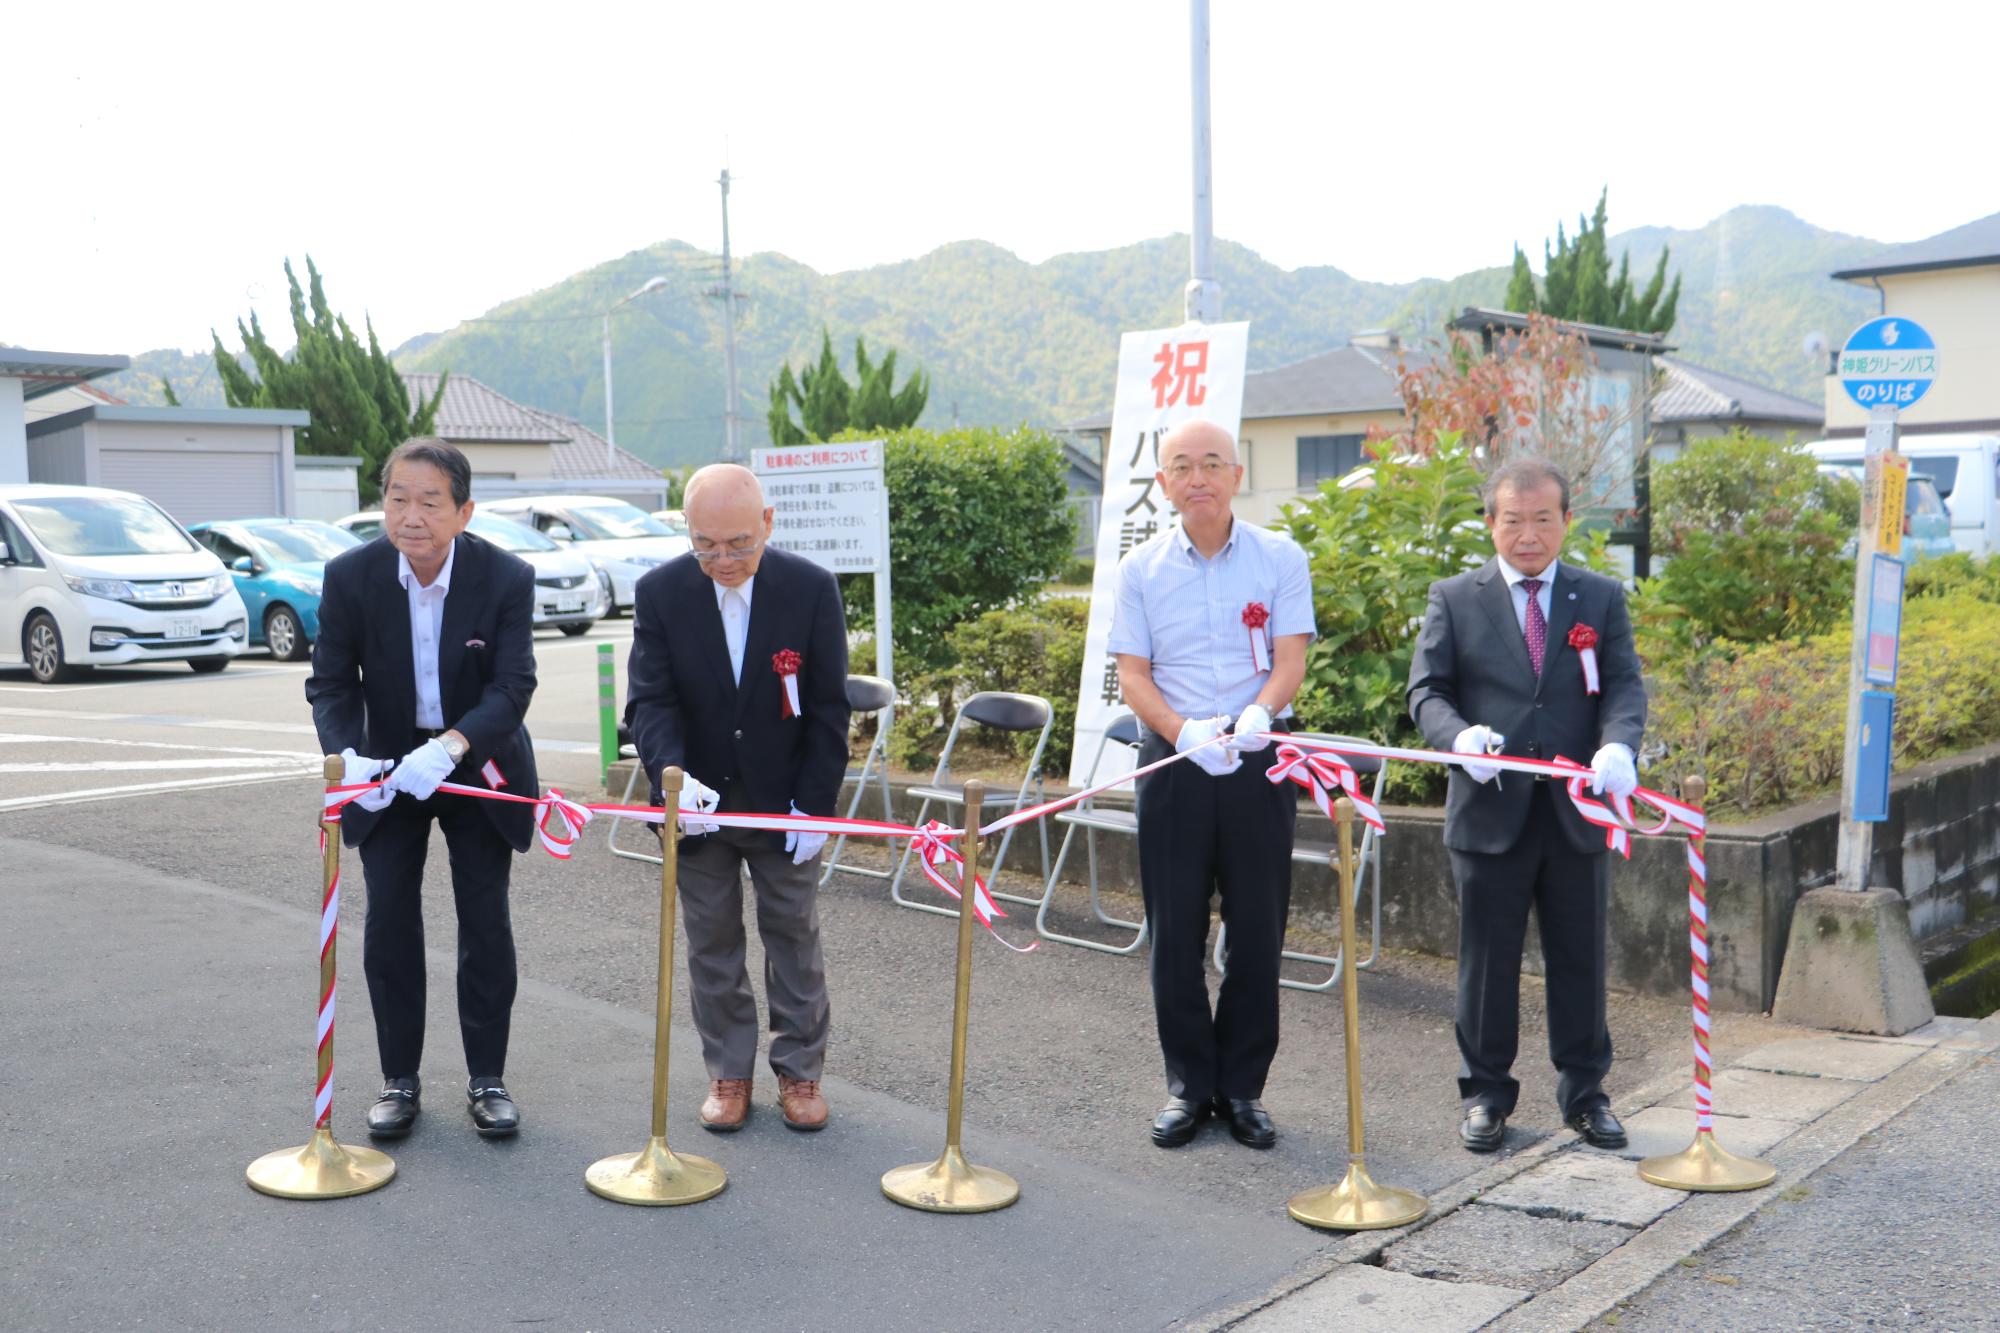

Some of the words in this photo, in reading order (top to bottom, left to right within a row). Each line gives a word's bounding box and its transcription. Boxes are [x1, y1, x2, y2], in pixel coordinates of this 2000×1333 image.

[1842, 356, 1936, 373] 神姫グリーンバス
[1151, 340, 1209, 409] 祝
[1857, 382, 1916, 402] のりば
[766, 450, 868, 468] 駐車場のご利用について
